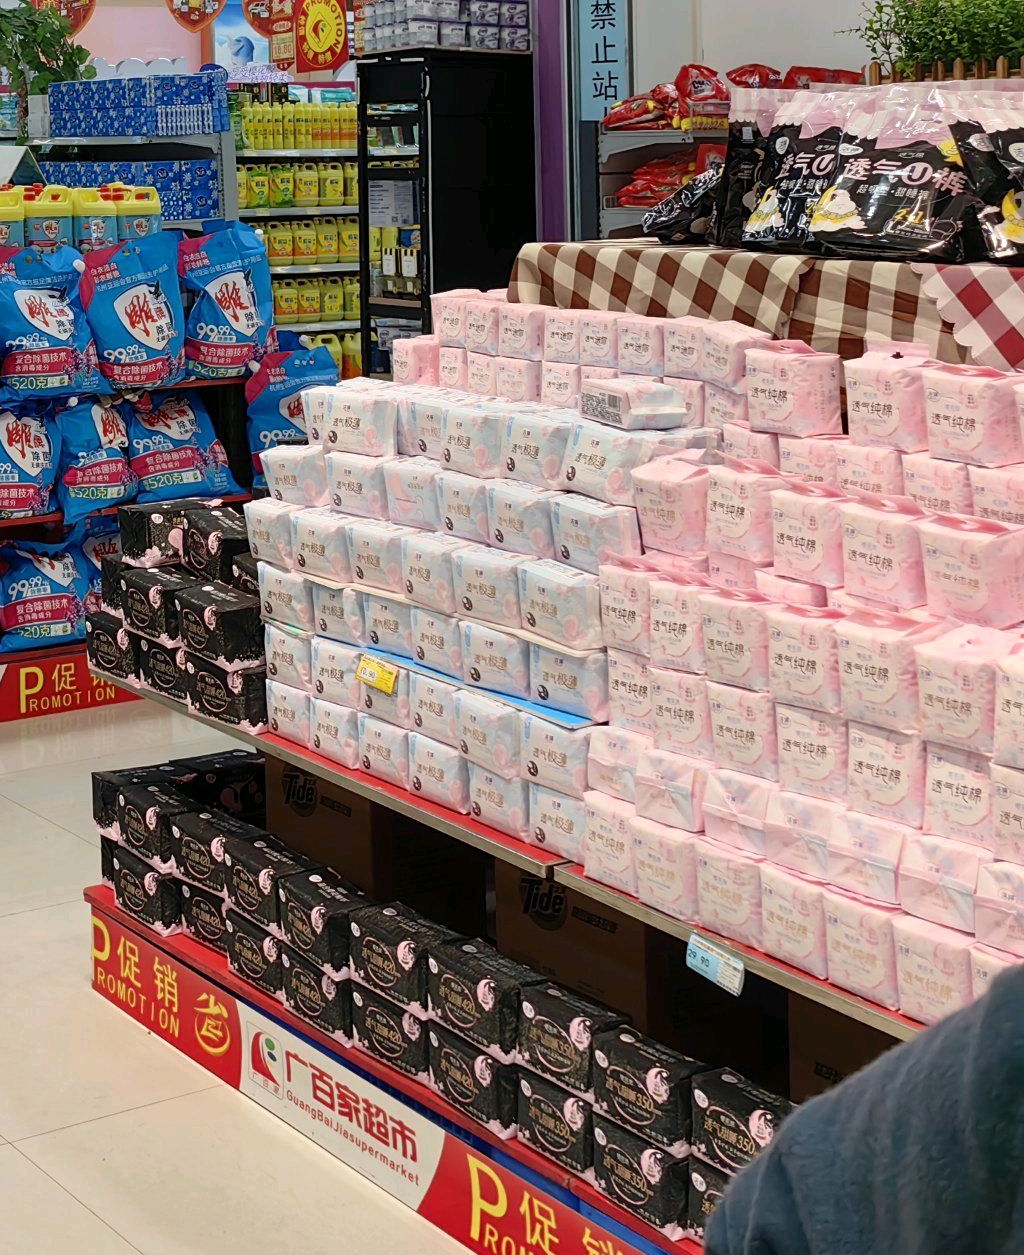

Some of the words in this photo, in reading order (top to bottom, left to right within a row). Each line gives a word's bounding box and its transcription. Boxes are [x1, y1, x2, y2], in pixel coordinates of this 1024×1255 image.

[15, 352, 68, 364] 复合除菌技术
[200, 346, 249, 357] 复合除菌技术
[113, 361, 164, 375] 复合除菌技术
[851, 400, 894, 419] 透气纯棉
[931, 412, 977, 433] 透气纯棉
[16, 600, 69, 614] 复合除菌技术
[18, 625, 50, 639] 20克
[281, 771, 316, 806] Tide
[520, 876, 564, 914] Tide
[117, 935, 178, 1013] 促销
[284, 1050, 418, 1163] 广百家超市
[286, 1089, 420, 1187] GuangBaiJiasupermarket
